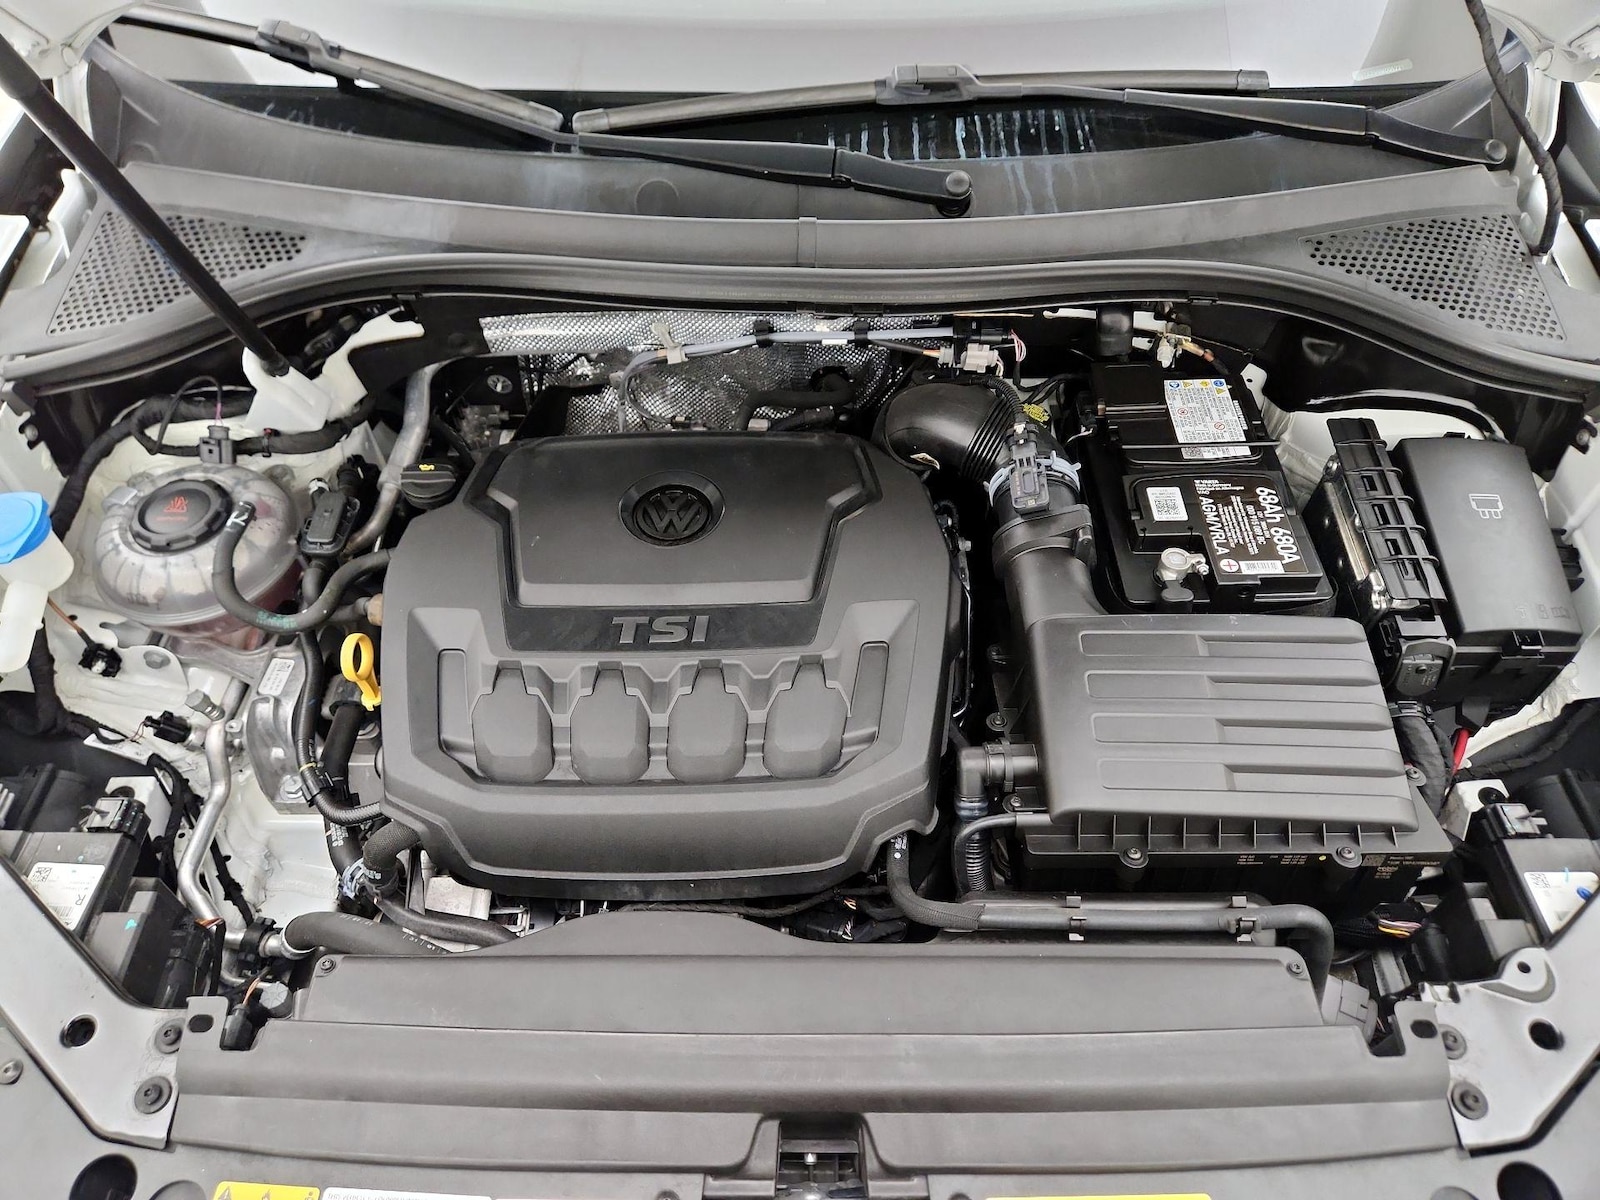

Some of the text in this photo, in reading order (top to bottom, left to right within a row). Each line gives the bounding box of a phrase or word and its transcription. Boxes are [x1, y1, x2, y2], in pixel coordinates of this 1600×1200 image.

[1199, 496, 1230, 555] AGM/VRLA
[1256, 487, 1301, 564] 68Ah 680A
[612, 615, 711, 644] TSI
